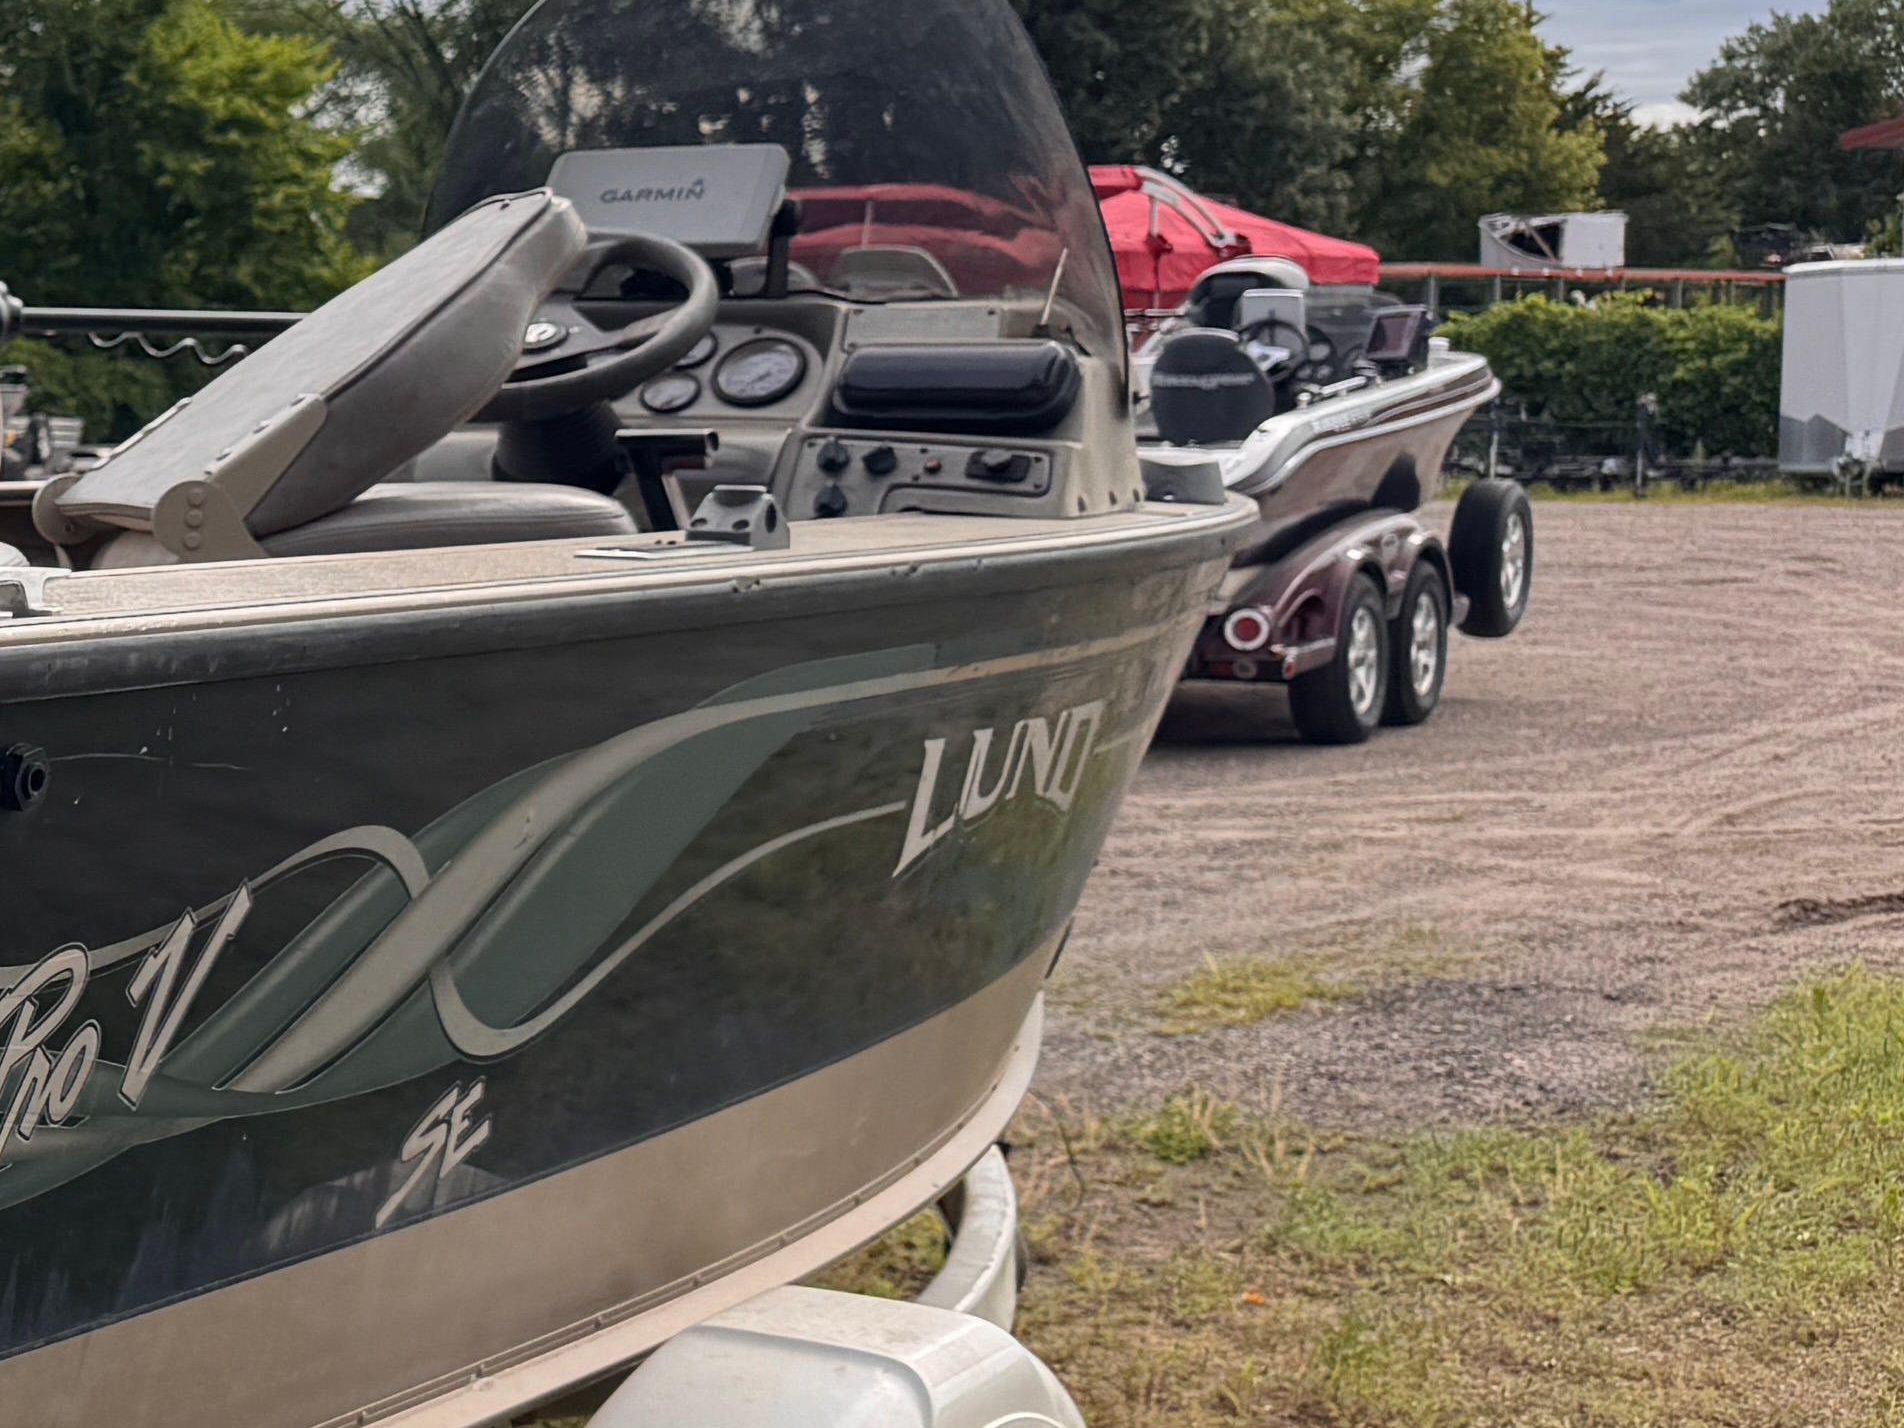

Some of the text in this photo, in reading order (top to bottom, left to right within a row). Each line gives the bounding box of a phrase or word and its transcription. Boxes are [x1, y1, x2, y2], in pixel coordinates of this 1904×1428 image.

[599, 184, 705, 203] GARMIN
[892, 700, 1102, 879] LUND
[117, 877, 252, 1111] V
[375, 1077, 492, 1229] SE
